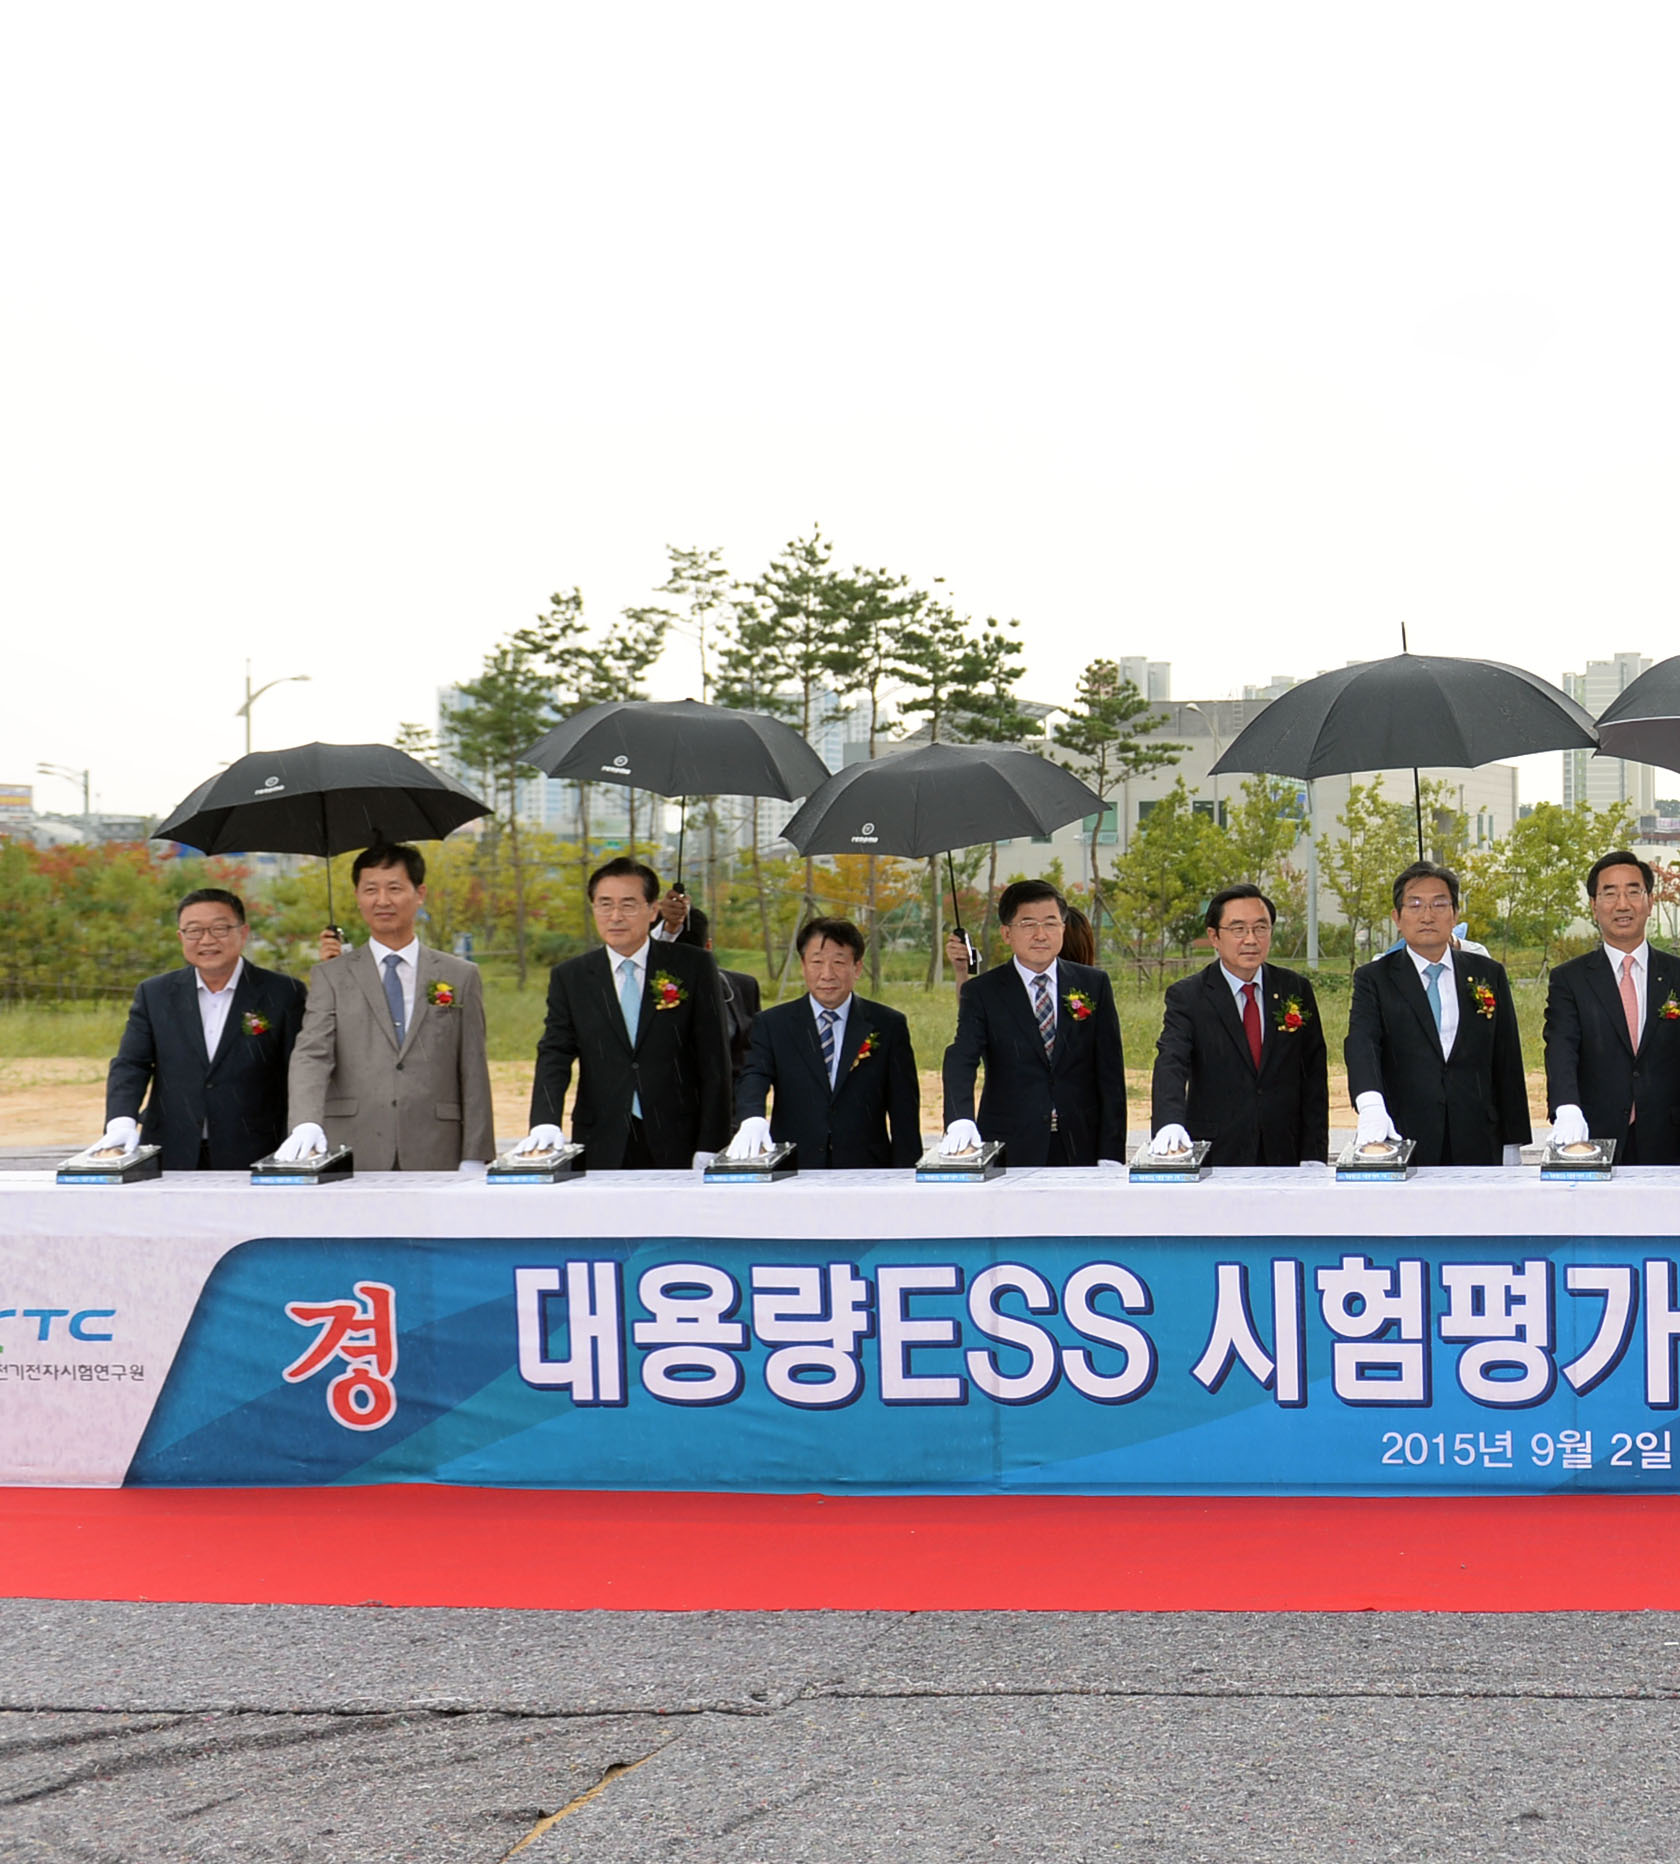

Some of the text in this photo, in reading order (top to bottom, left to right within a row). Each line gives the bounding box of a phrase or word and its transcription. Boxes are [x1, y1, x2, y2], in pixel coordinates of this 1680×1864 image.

[0, 1308, 117, 1342] TC
[283, 1281, 398, 1431] 경
[513, 1261, 1152, 1404] 대용량ESS
[1380, 1430, 1513, 1468] 2015년
[1531, 1429, 1593, 1469] 9월
[1609, 1430, 1672, 1470] 2일
